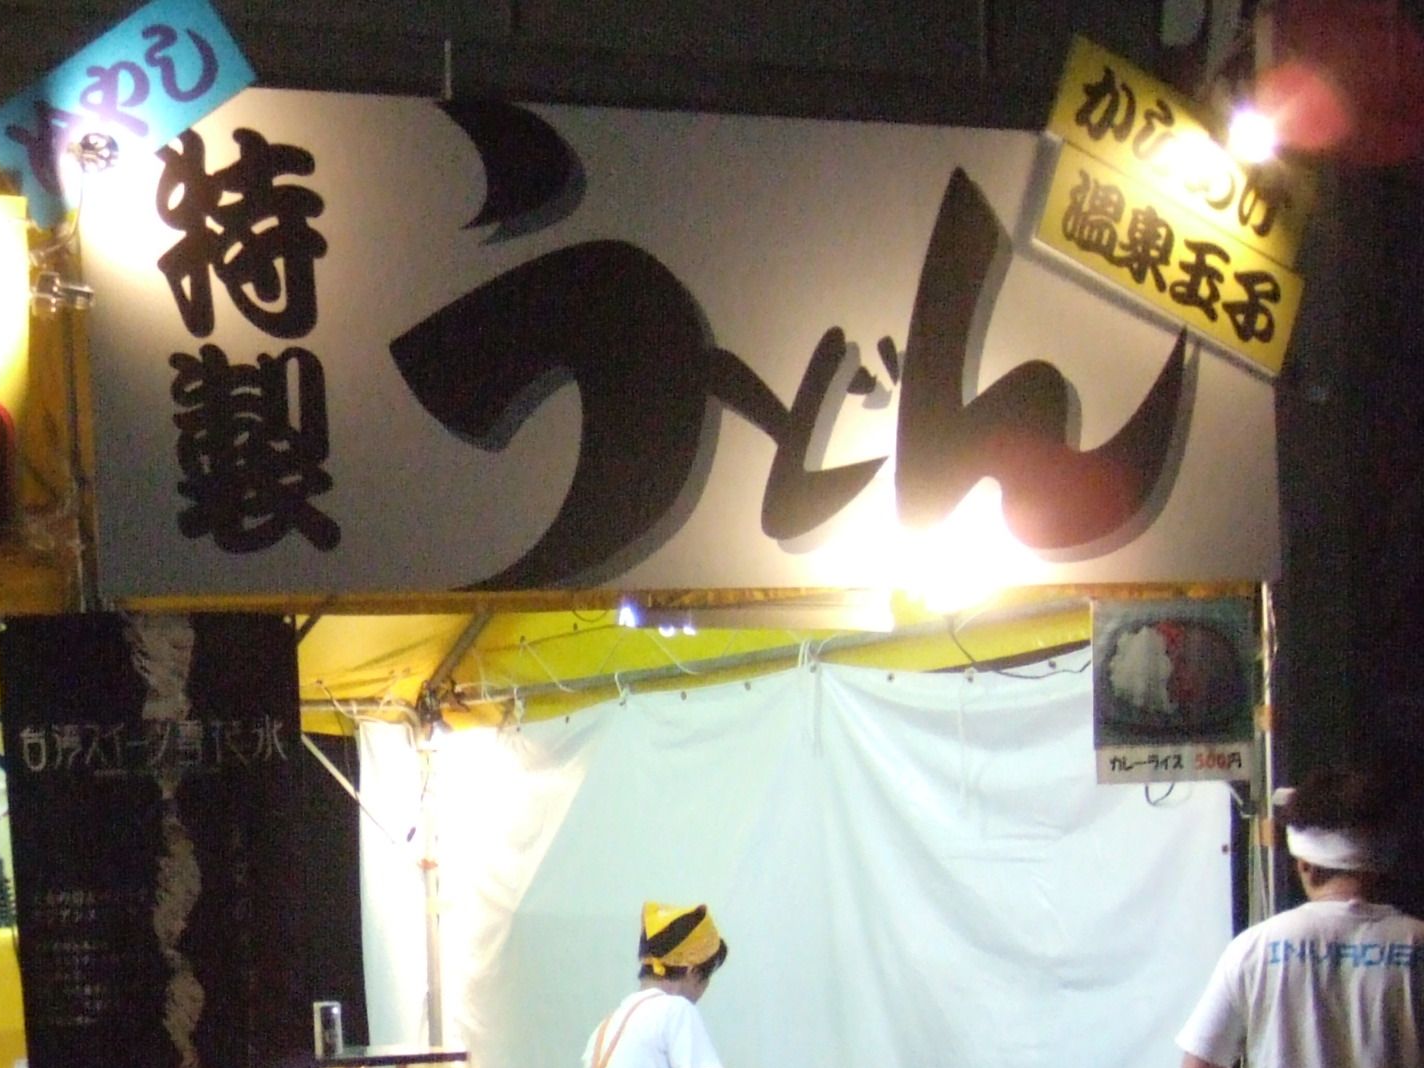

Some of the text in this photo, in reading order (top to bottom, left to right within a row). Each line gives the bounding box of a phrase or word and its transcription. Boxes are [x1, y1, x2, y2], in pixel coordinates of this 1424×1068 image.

[156, 127, 340, 552] 特製
[388, 98, 1188, 592] うどん
[1061, 168, 1282, 343] 温泉玉子
[1109, 751, 1243, 771] カレーライス 500円
